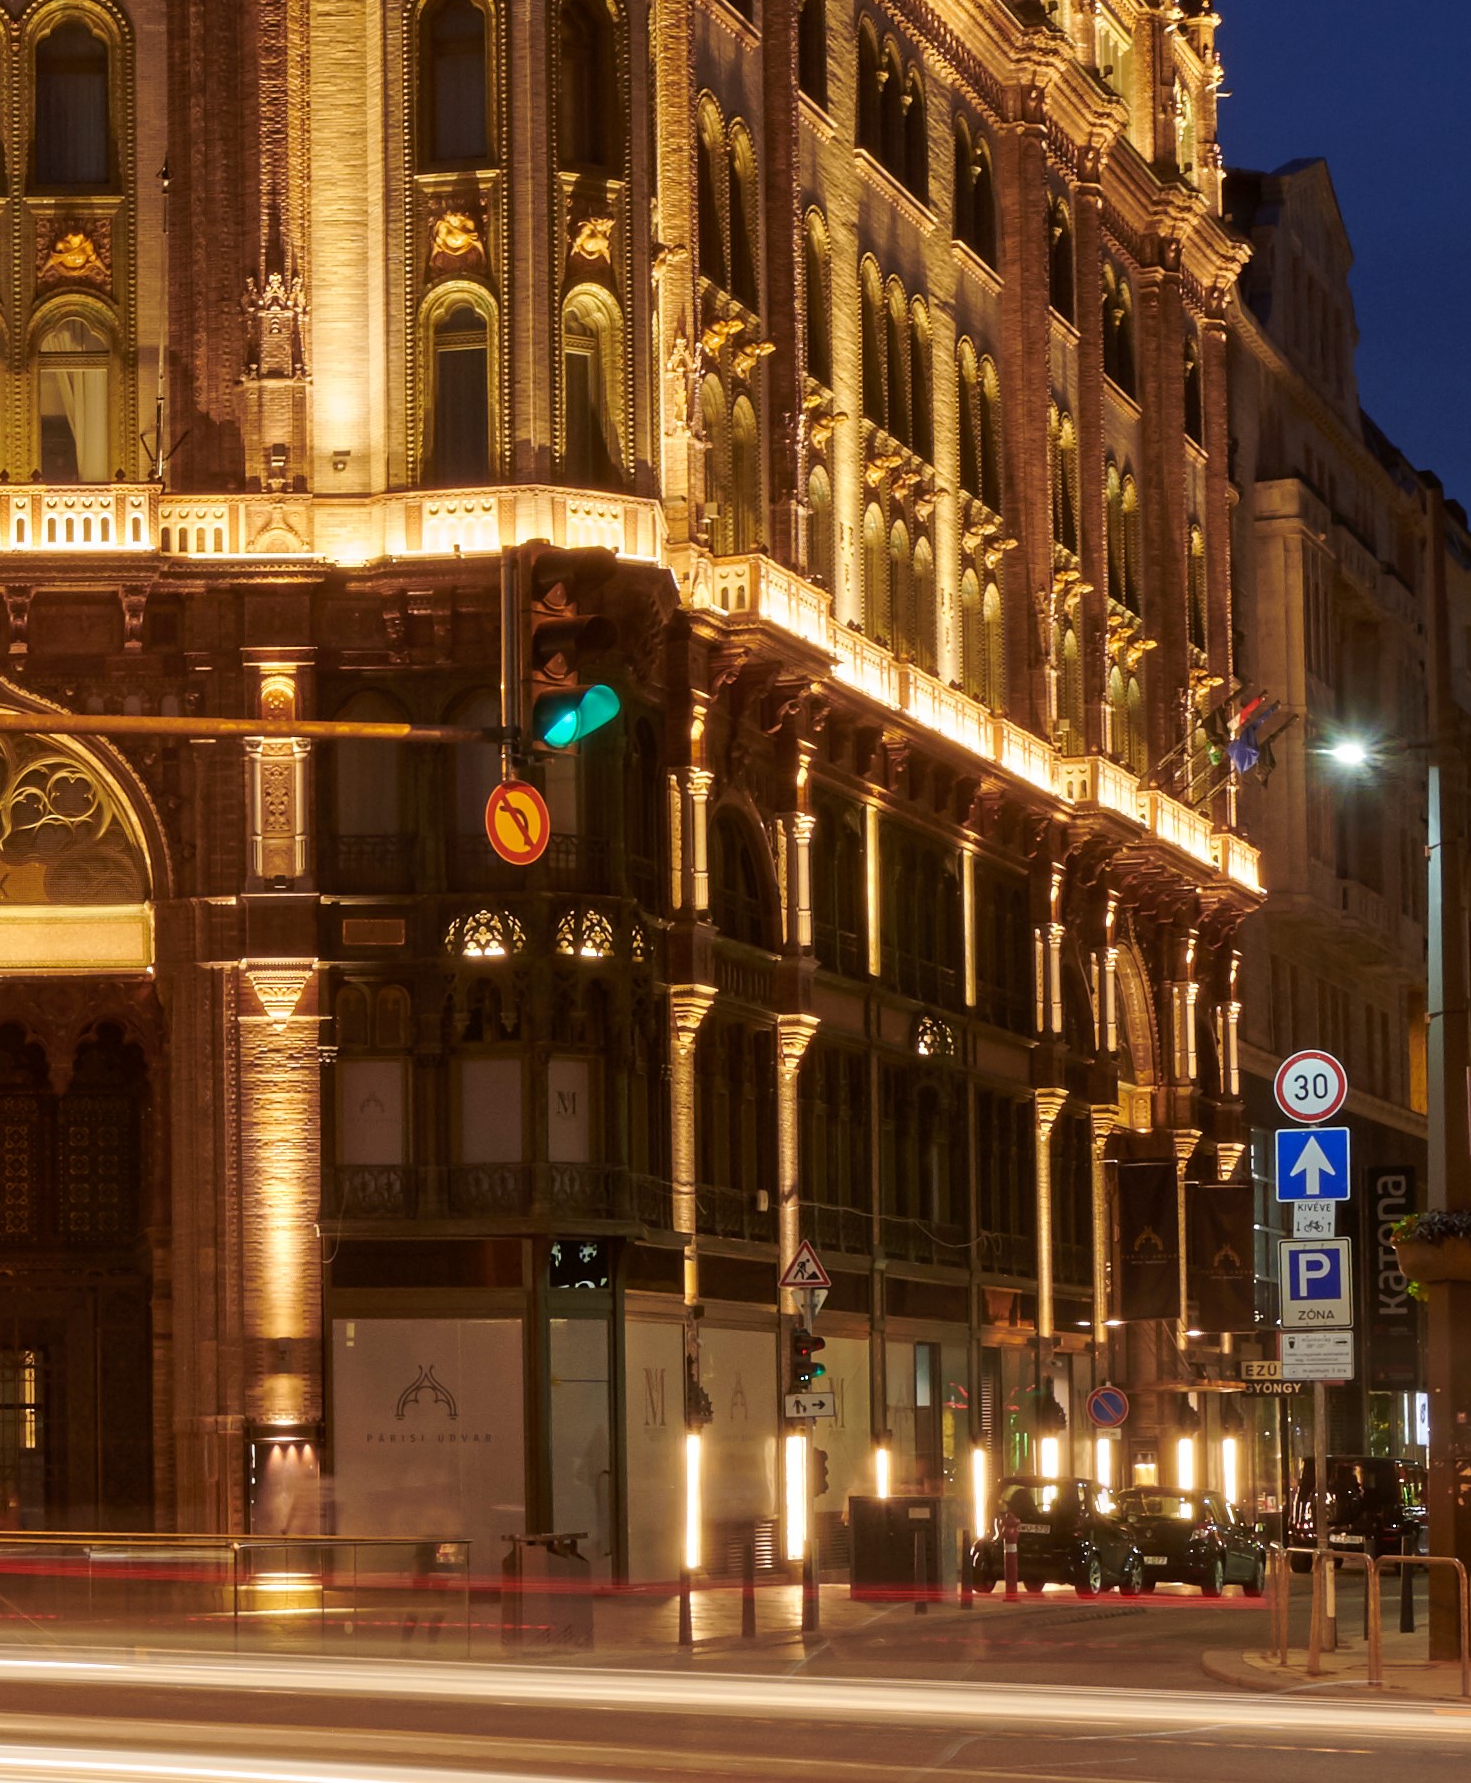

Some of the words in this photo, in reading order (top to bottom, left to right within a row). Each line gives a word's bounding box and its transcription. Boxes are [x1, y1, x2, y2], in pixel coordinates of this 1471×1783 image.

[1294, 1073, 1328, 1101] 30
[1297, 1203, 1331, 1213] KIVÉVE
[1298, 1252, 1331, 1297] P
[1298, 1308, 1335, 1321] ZÓNA
[1245, 1381, 1301, 1394] GYÖNGY
